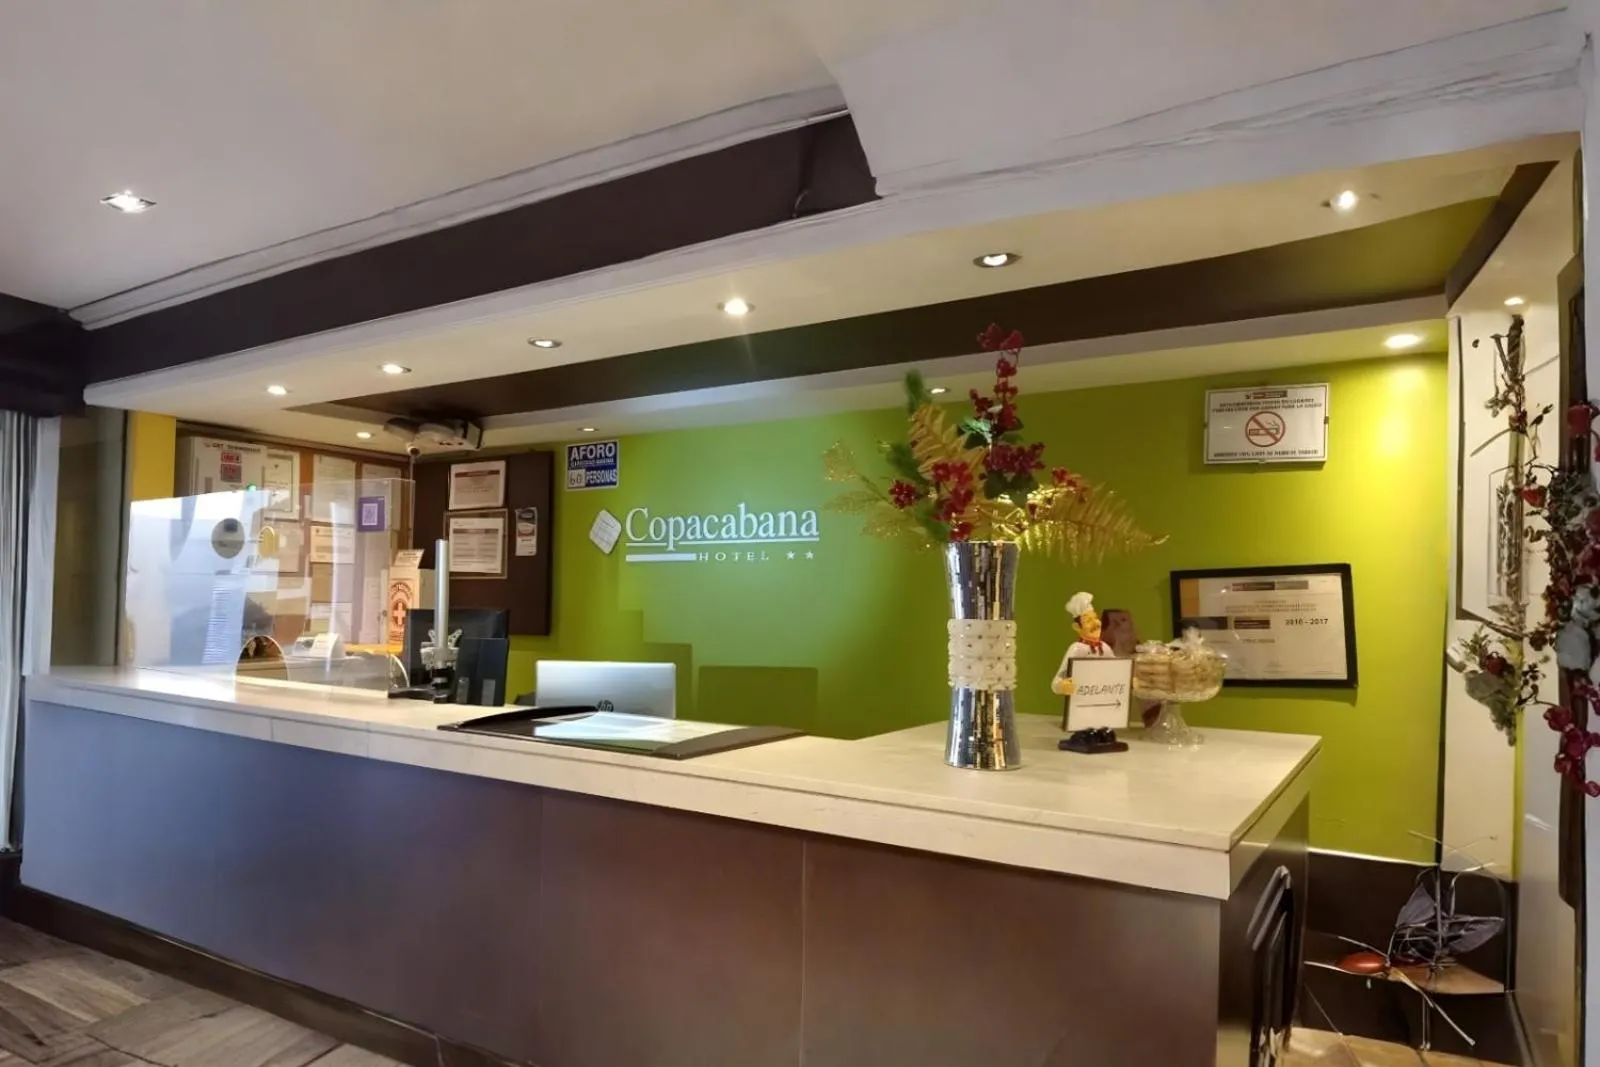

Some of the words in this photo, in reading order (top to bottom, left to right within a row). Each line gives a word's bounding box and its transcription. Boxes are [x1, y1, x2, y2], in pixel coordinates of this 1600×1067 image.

[571, 443, 616, 460] AFORO
[586, 469, 617, 484] PERSONAS
[625, 501, 820, 551] Copacabana
[699, 551, 770, 562] HOTEL
[1078, 683, 1126, 696] ADELANTE
